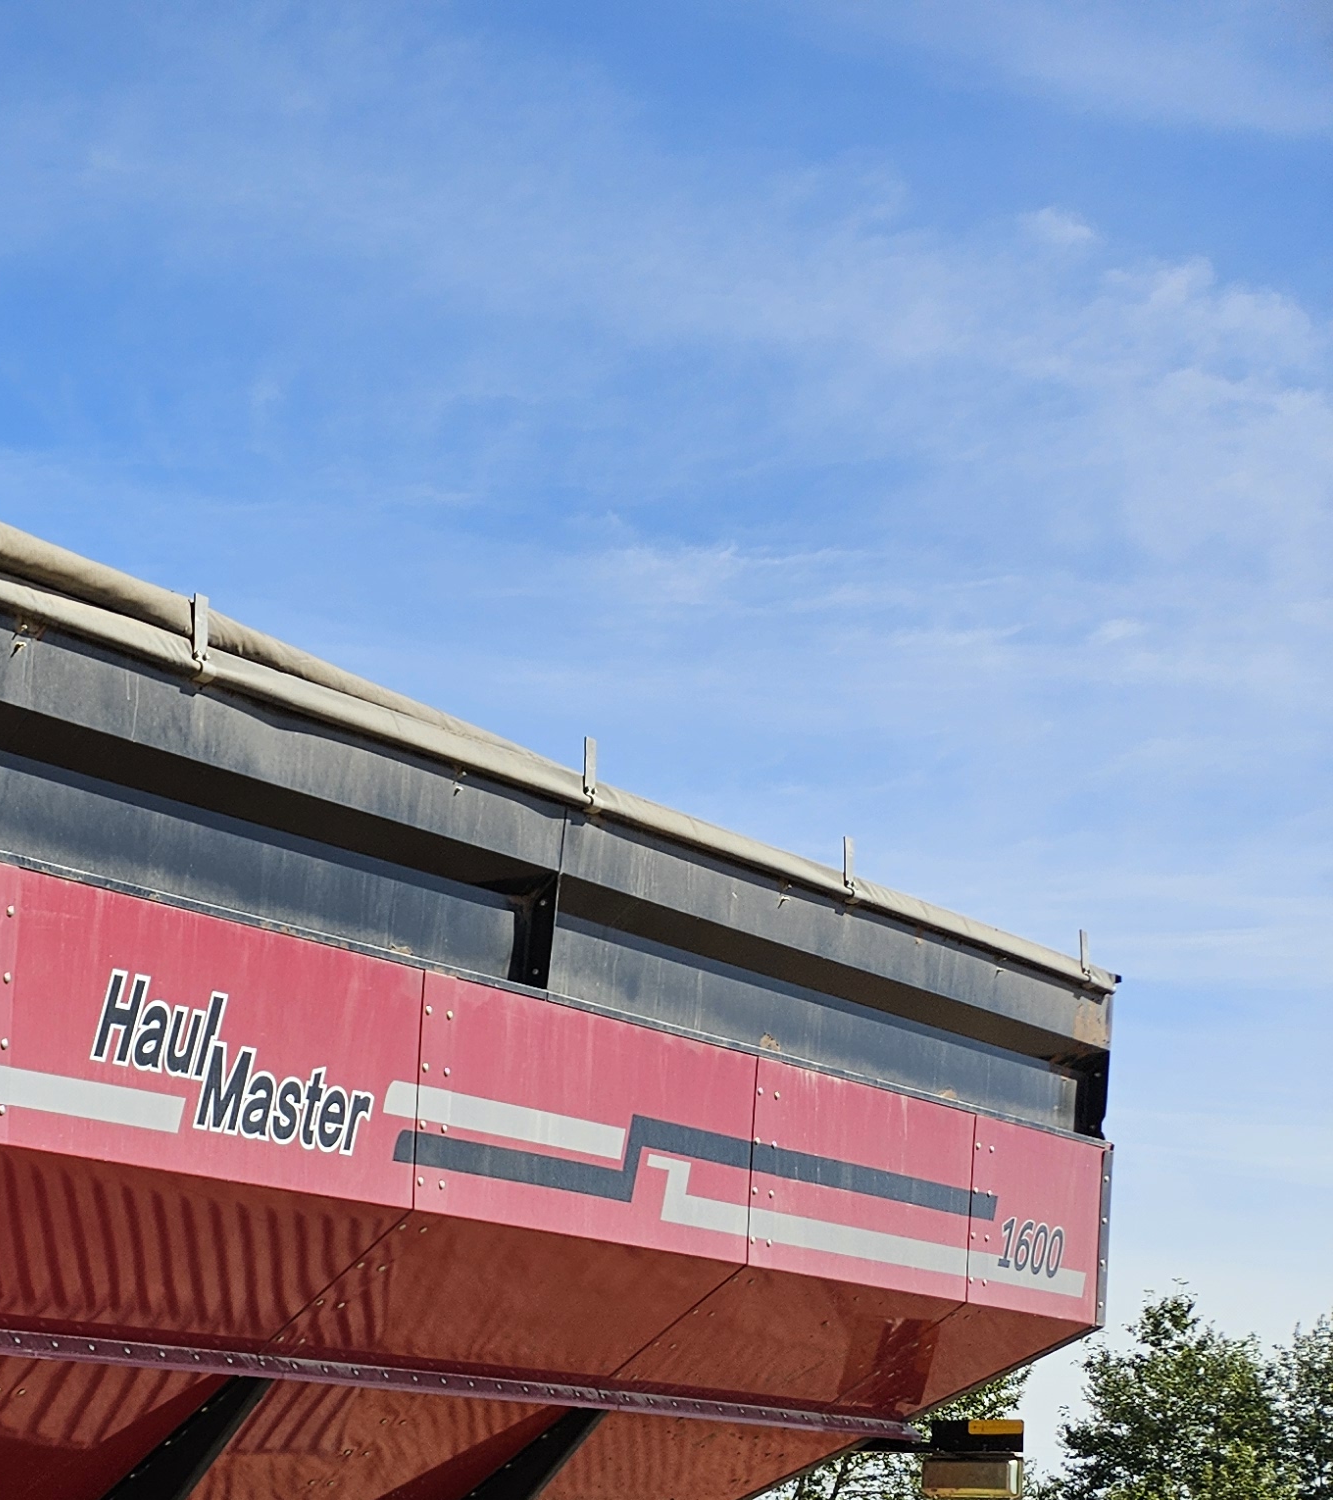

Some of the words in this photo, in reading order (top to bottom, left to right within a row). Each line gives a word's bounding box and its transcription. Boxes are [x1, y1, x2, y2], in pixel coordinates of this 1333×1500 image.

[90, 968, 228, 1081] Haul
[193, 1038, 375, 1156] Master
[997, 1216, 1065, 1278] 1600
